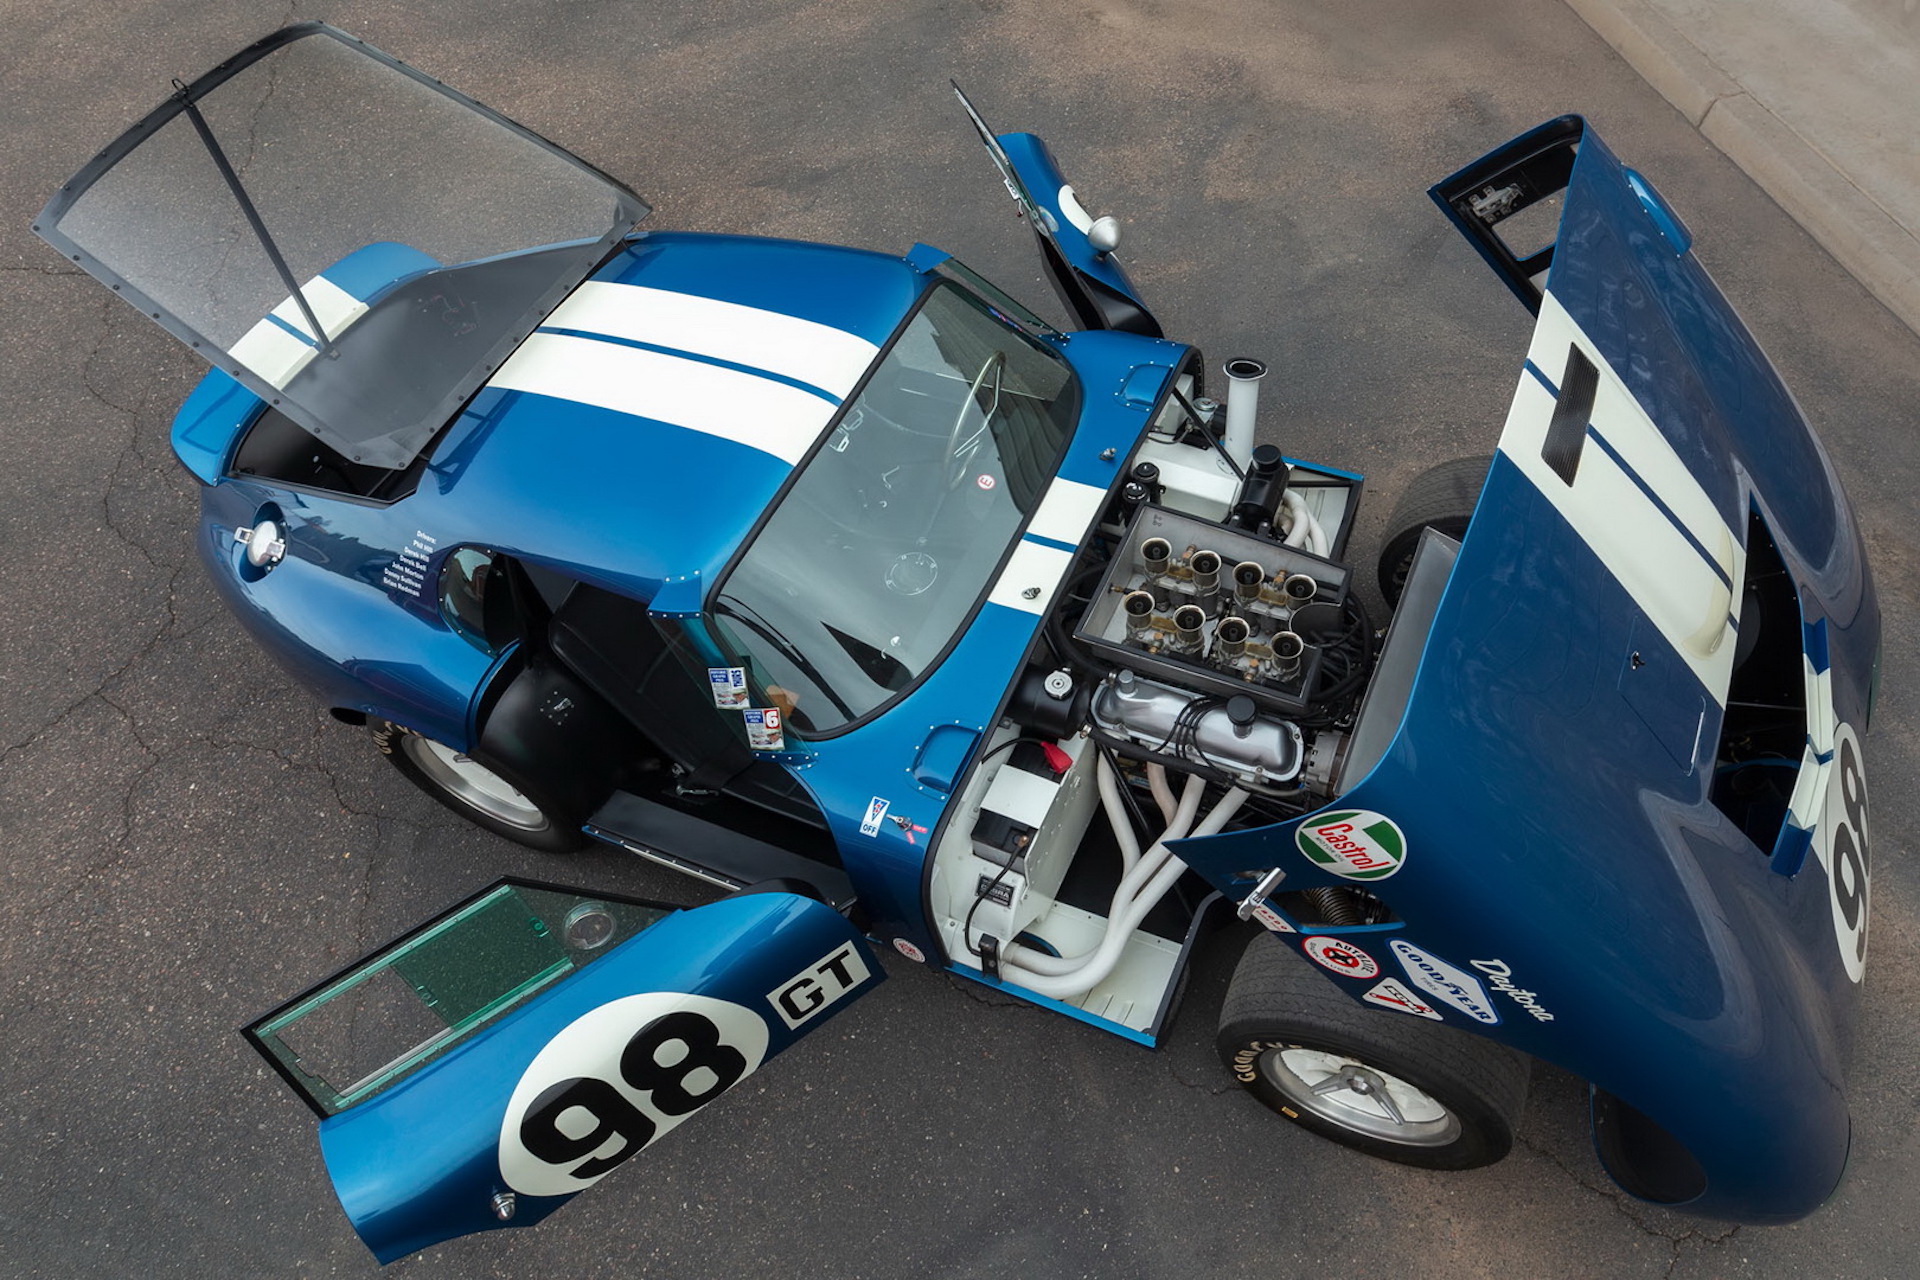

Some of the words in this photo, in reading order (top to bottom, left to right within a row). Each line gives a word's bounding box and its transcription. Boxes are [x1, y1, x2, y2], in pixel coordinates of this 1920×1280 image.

[980, 477, 992, 486] E
[403, 546, 420, 559] Derek
[420, 553, 430, 563] Hill
[413, 540, 424, 549] Phil
[423, 544, 434, 553] Hill
[392, 561, 404, 571] John
[404, 566, 424, 580] Morton
[399, 554, 416, 567] Derek
[415, 561, 427, 572] Bell
[383, 577, 397, 587] Brian
[398, 583, 421, 597] Redman
[384, 567, 400, 580] Danny
[400, 575, 422, 589] Sullivan
[766, 711, 779, 728] 6
[863, 824, 878, 834] OFF
[1317, 823, 1391, 870] Castrol
[778, 949, 851, 1021] GT
[1397, 944, 1493, 1020] GOODYEAR
[1469, 959, 1555, 1022] Daytona
[1383, 985, 1428, 1014] KONI
[520, 1011, 748, 1180] 98
